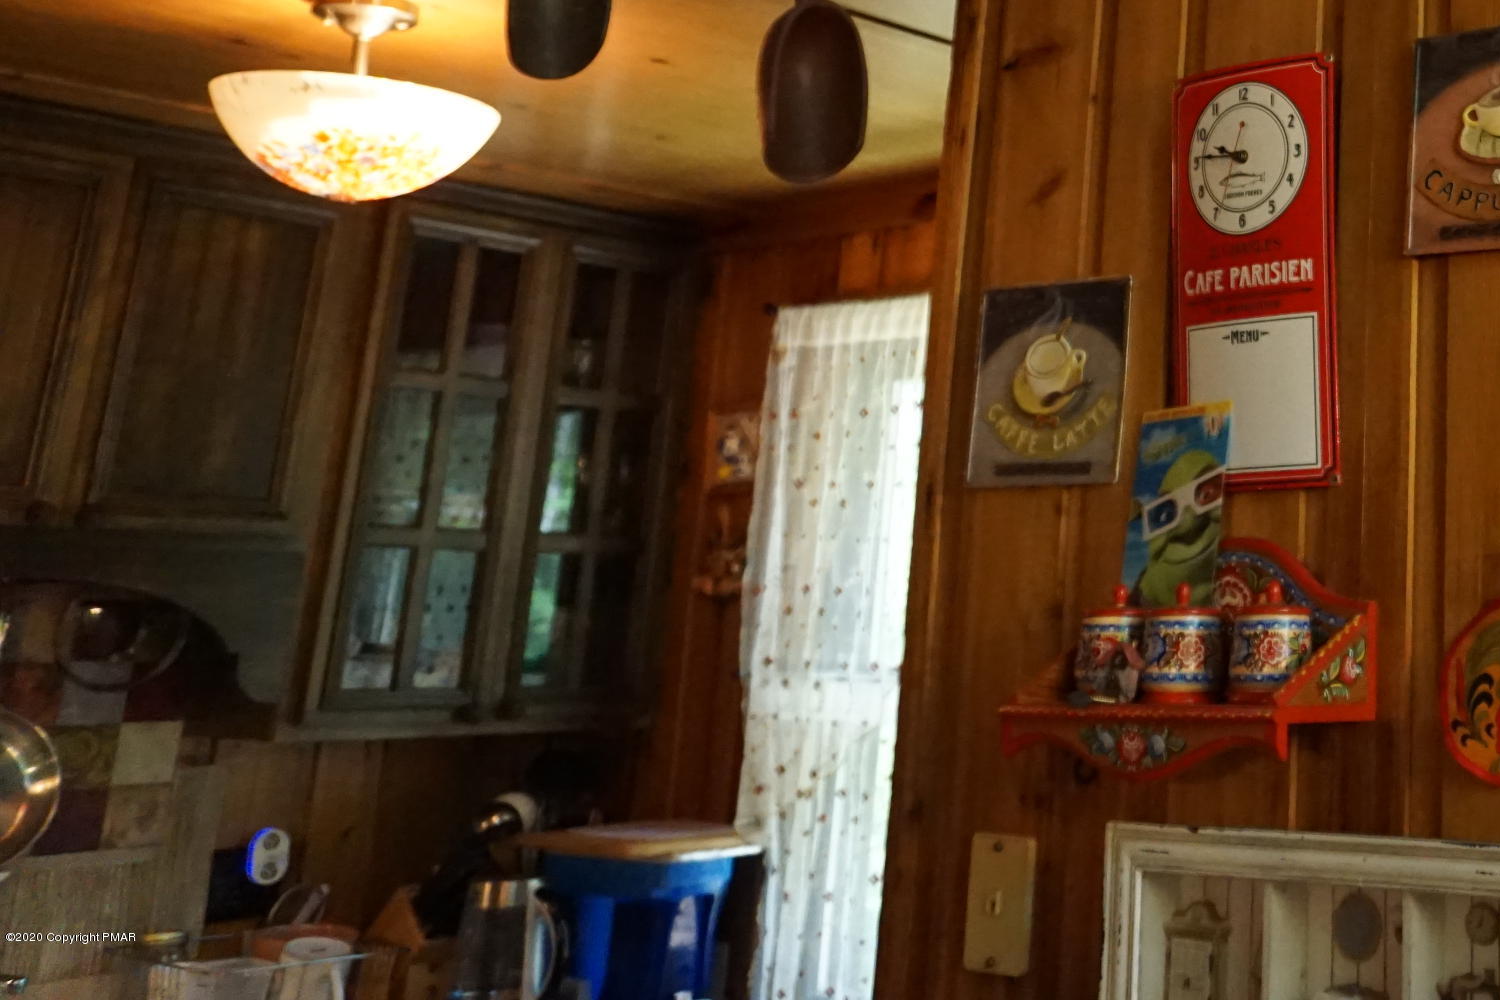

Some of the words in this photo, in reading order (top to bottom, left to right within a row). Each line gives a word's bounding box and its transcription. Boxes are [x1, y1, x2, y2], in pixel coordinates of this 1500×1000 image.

[1239, 88, 1248, 101] 12
[1212, 103, 1219, 115] 11
[1288, 114, 1295, 128] 2
[1197, 128, 1207, 142] 10
[1294, 144, 1301, 157] 3
[1286, 173, 1294, 187] 4
[1198, 185, 1204, 199] 8
[1213, 207, 1220, 221] 7
[1268, 200, 1275, 214] 5
[1239, 214, 1246, 228] 6
[1184, 270, 1224, 296] CAFE
[1230, 258, 1313, 289] PARISIEN
